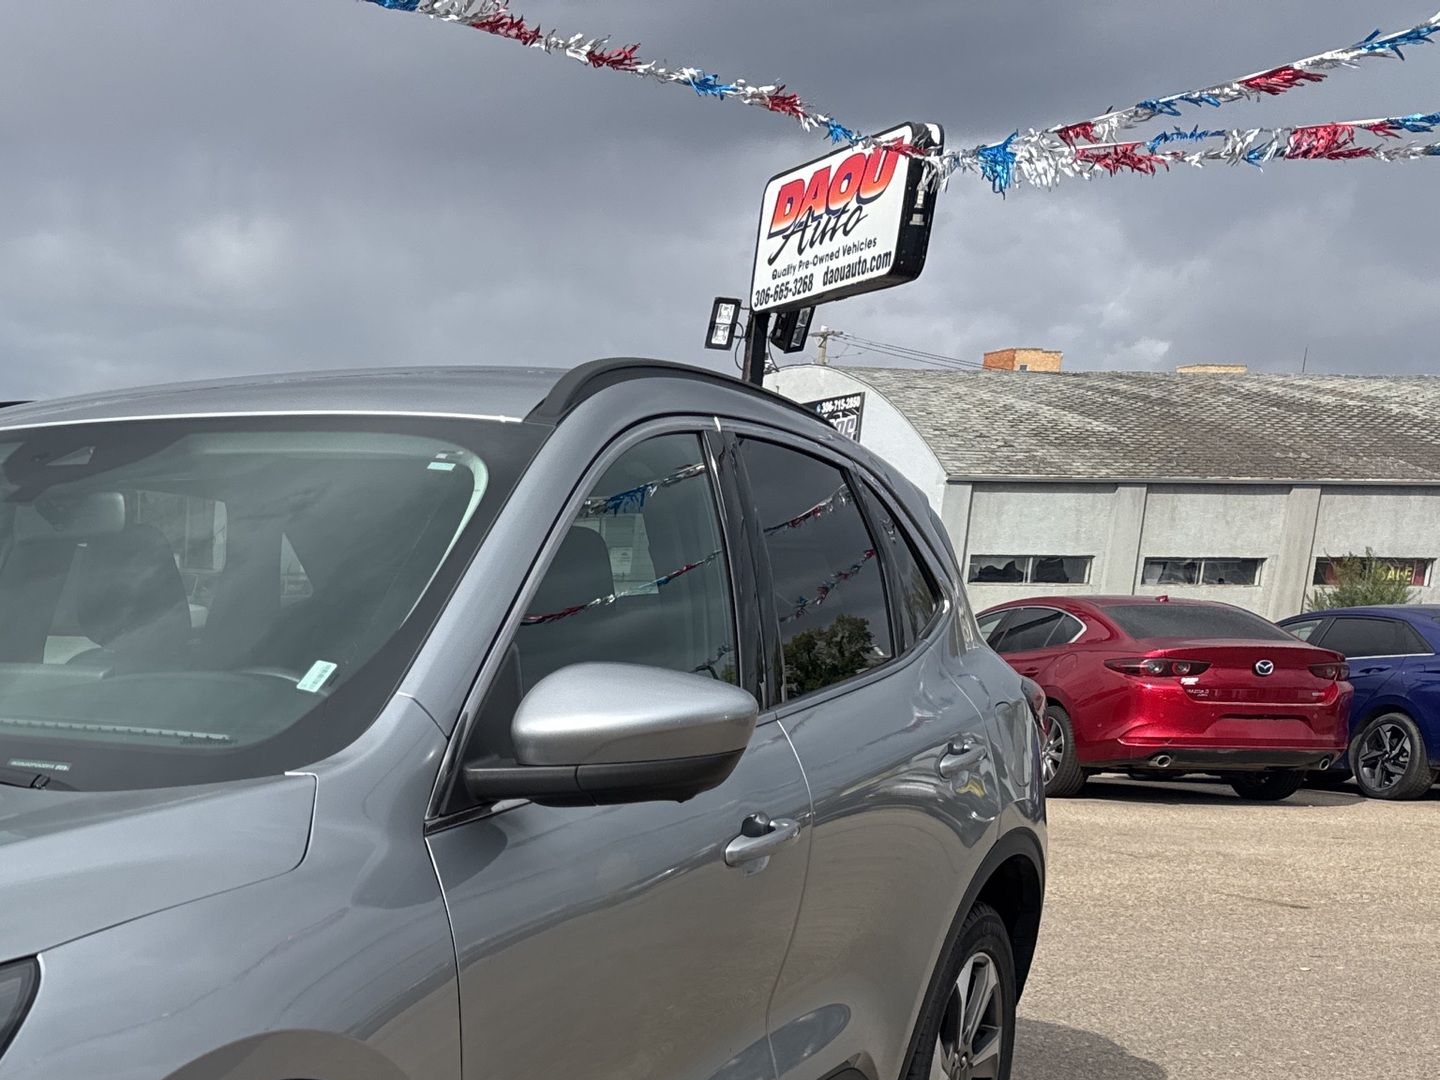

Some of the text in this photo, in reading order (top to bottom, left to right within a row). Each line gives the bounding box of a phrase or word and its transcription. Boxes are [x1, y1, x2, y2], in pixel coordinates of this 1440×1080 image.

[767, 136, 906, 240] DAOU
[767, 204, 869, 266] Auto
[772, 237, 878, 281] Quality Pre-Owned Vehicles
[754, 250, 893, 308] 306-665-3268 daouauto.com
